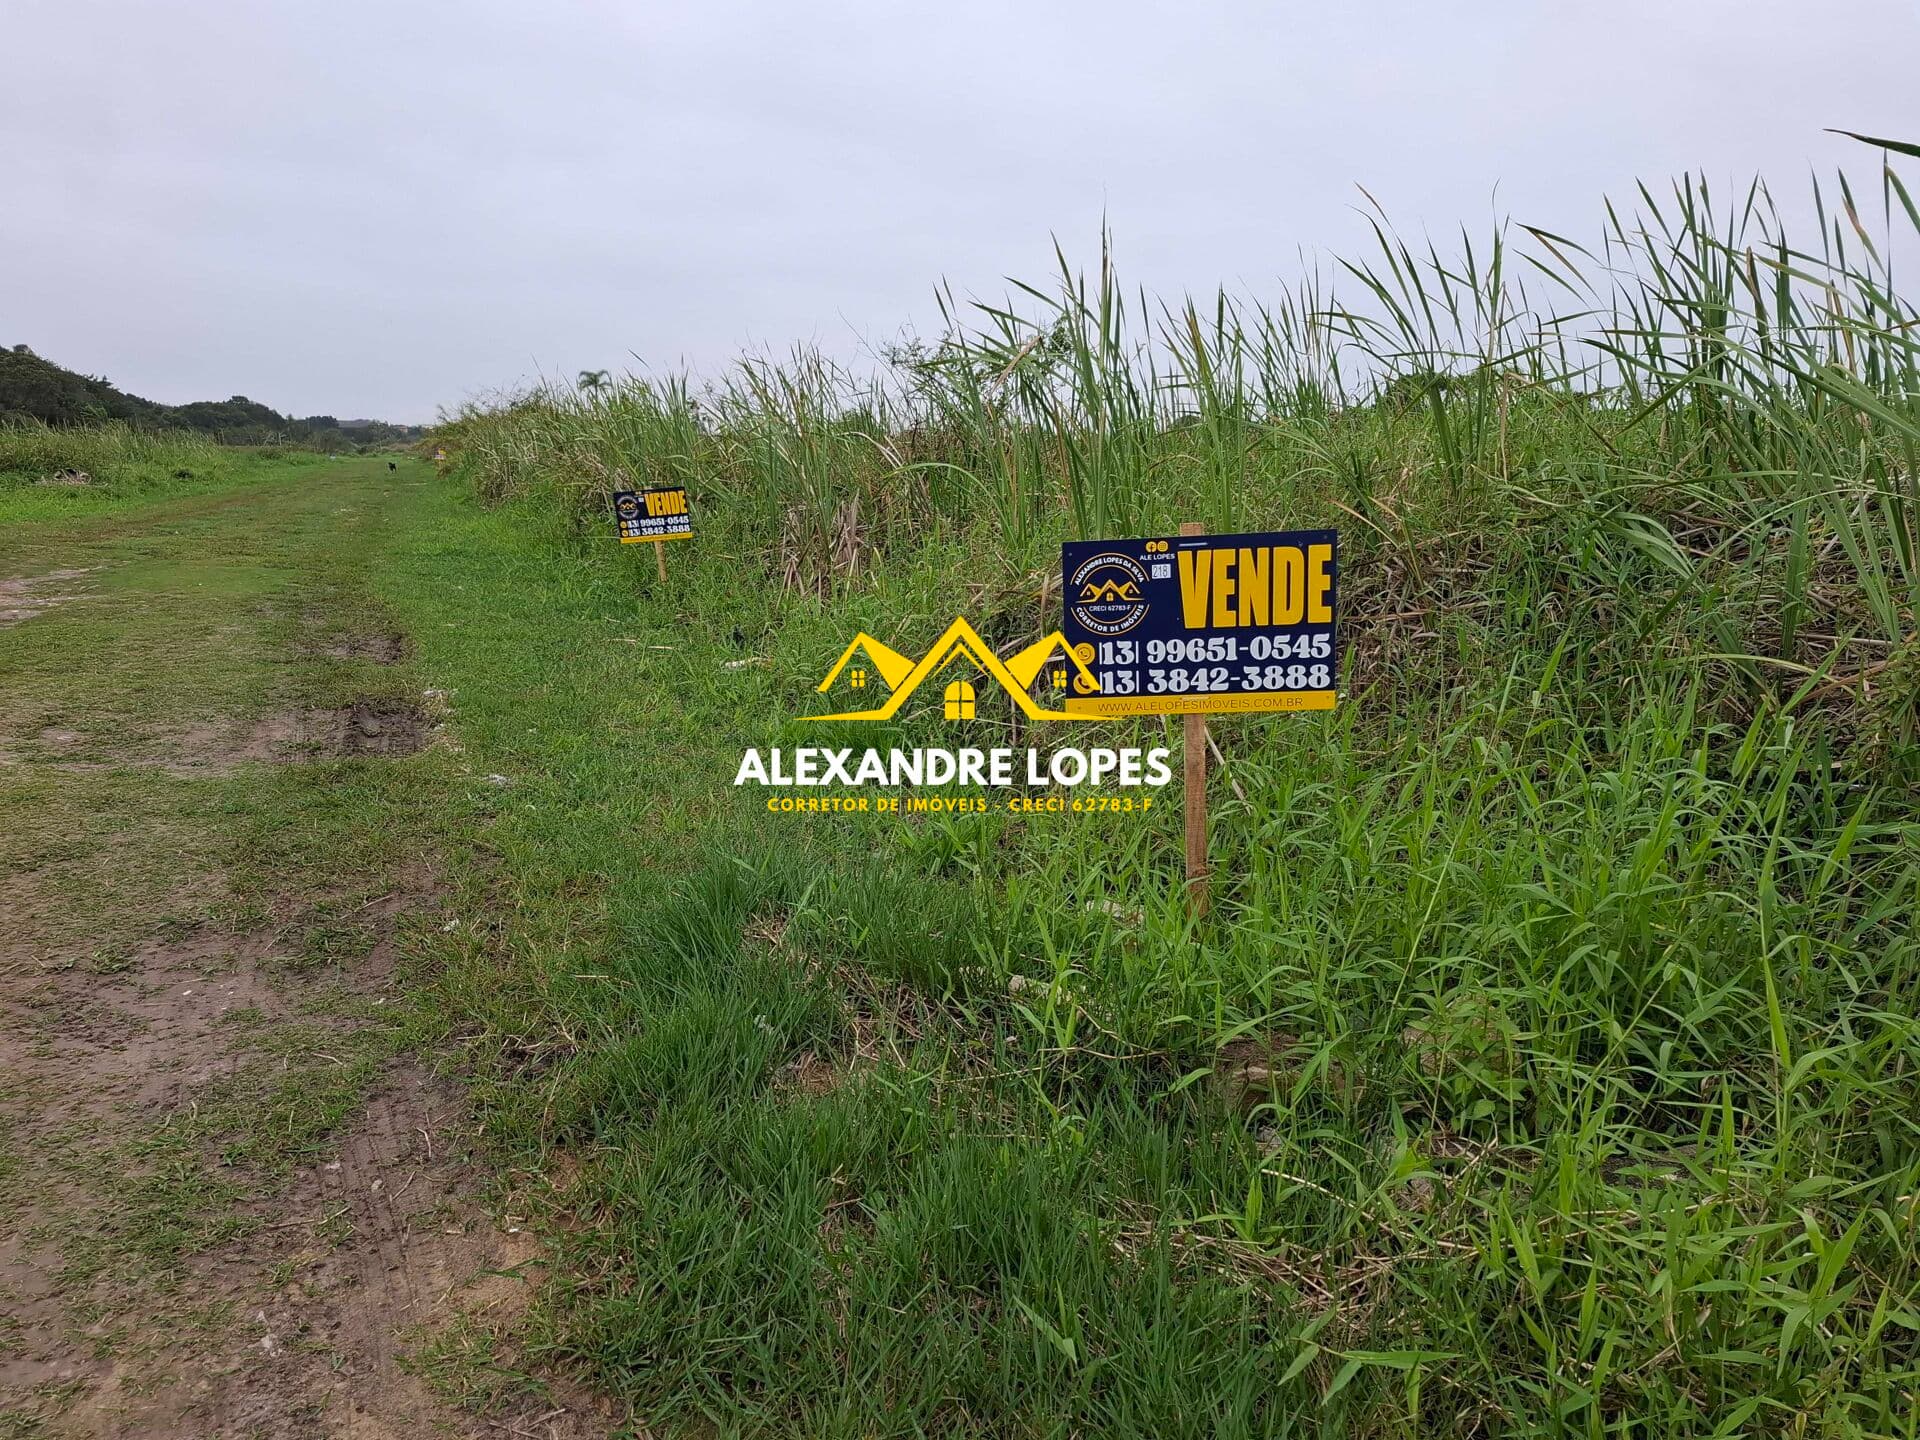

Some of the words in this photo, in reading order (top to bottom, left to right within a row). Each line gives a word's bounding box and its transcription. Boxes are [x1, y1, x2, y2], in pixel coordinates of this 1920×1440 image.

[644, 490, 687, 516] VENDE
[640, 516, 689, 527] 99651-0545
[642, 525, 690, 535] 3842-3888
[1075, 558, 1102, 585] ALEXANDRE
[1123, 560, 1132, 568] DA
[1131, 566, 1144, 582] SILVA
[1177, 544, 1332, 629] VENDE
[1076, 607, 1107, 632] CORRETOR
[1121, 605, 1144, 629] IMÓVEIS
[1146, 633, 1331, 664] 99651-0545
[1147, 664, 1331, 693] 3842-3888
